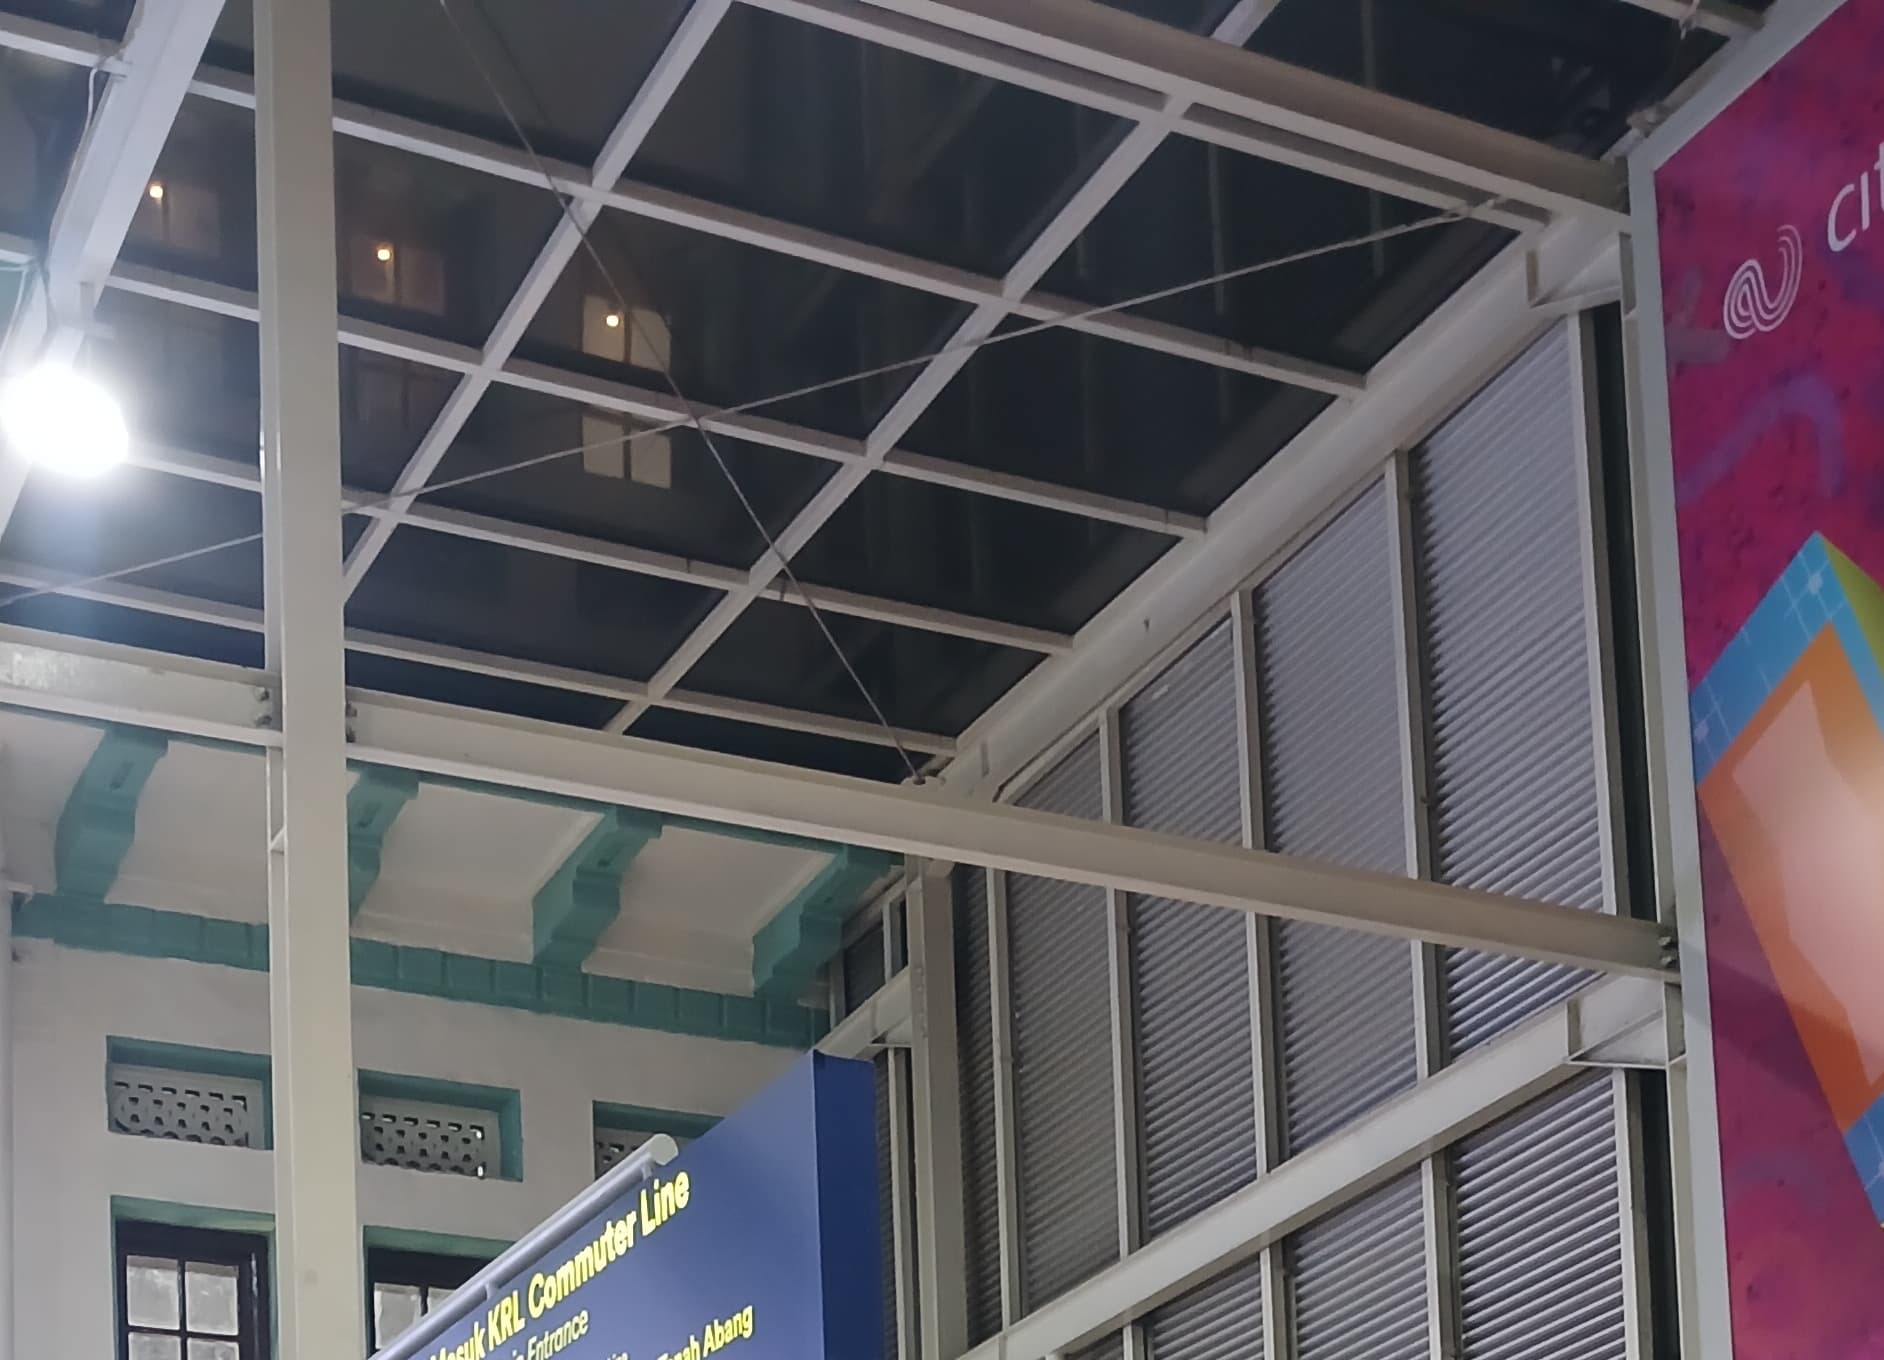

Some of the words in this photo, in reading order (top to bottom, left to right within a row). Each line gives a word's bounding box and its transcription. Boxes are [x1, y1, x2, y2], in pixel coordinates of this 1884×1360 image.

[488, 1290, 526, 1350] KRL
[528, 1210, 637, 1318] Commuter
[640, 1171, 690, 1236] Line
[703, 1305, 753, 1357] Abang
